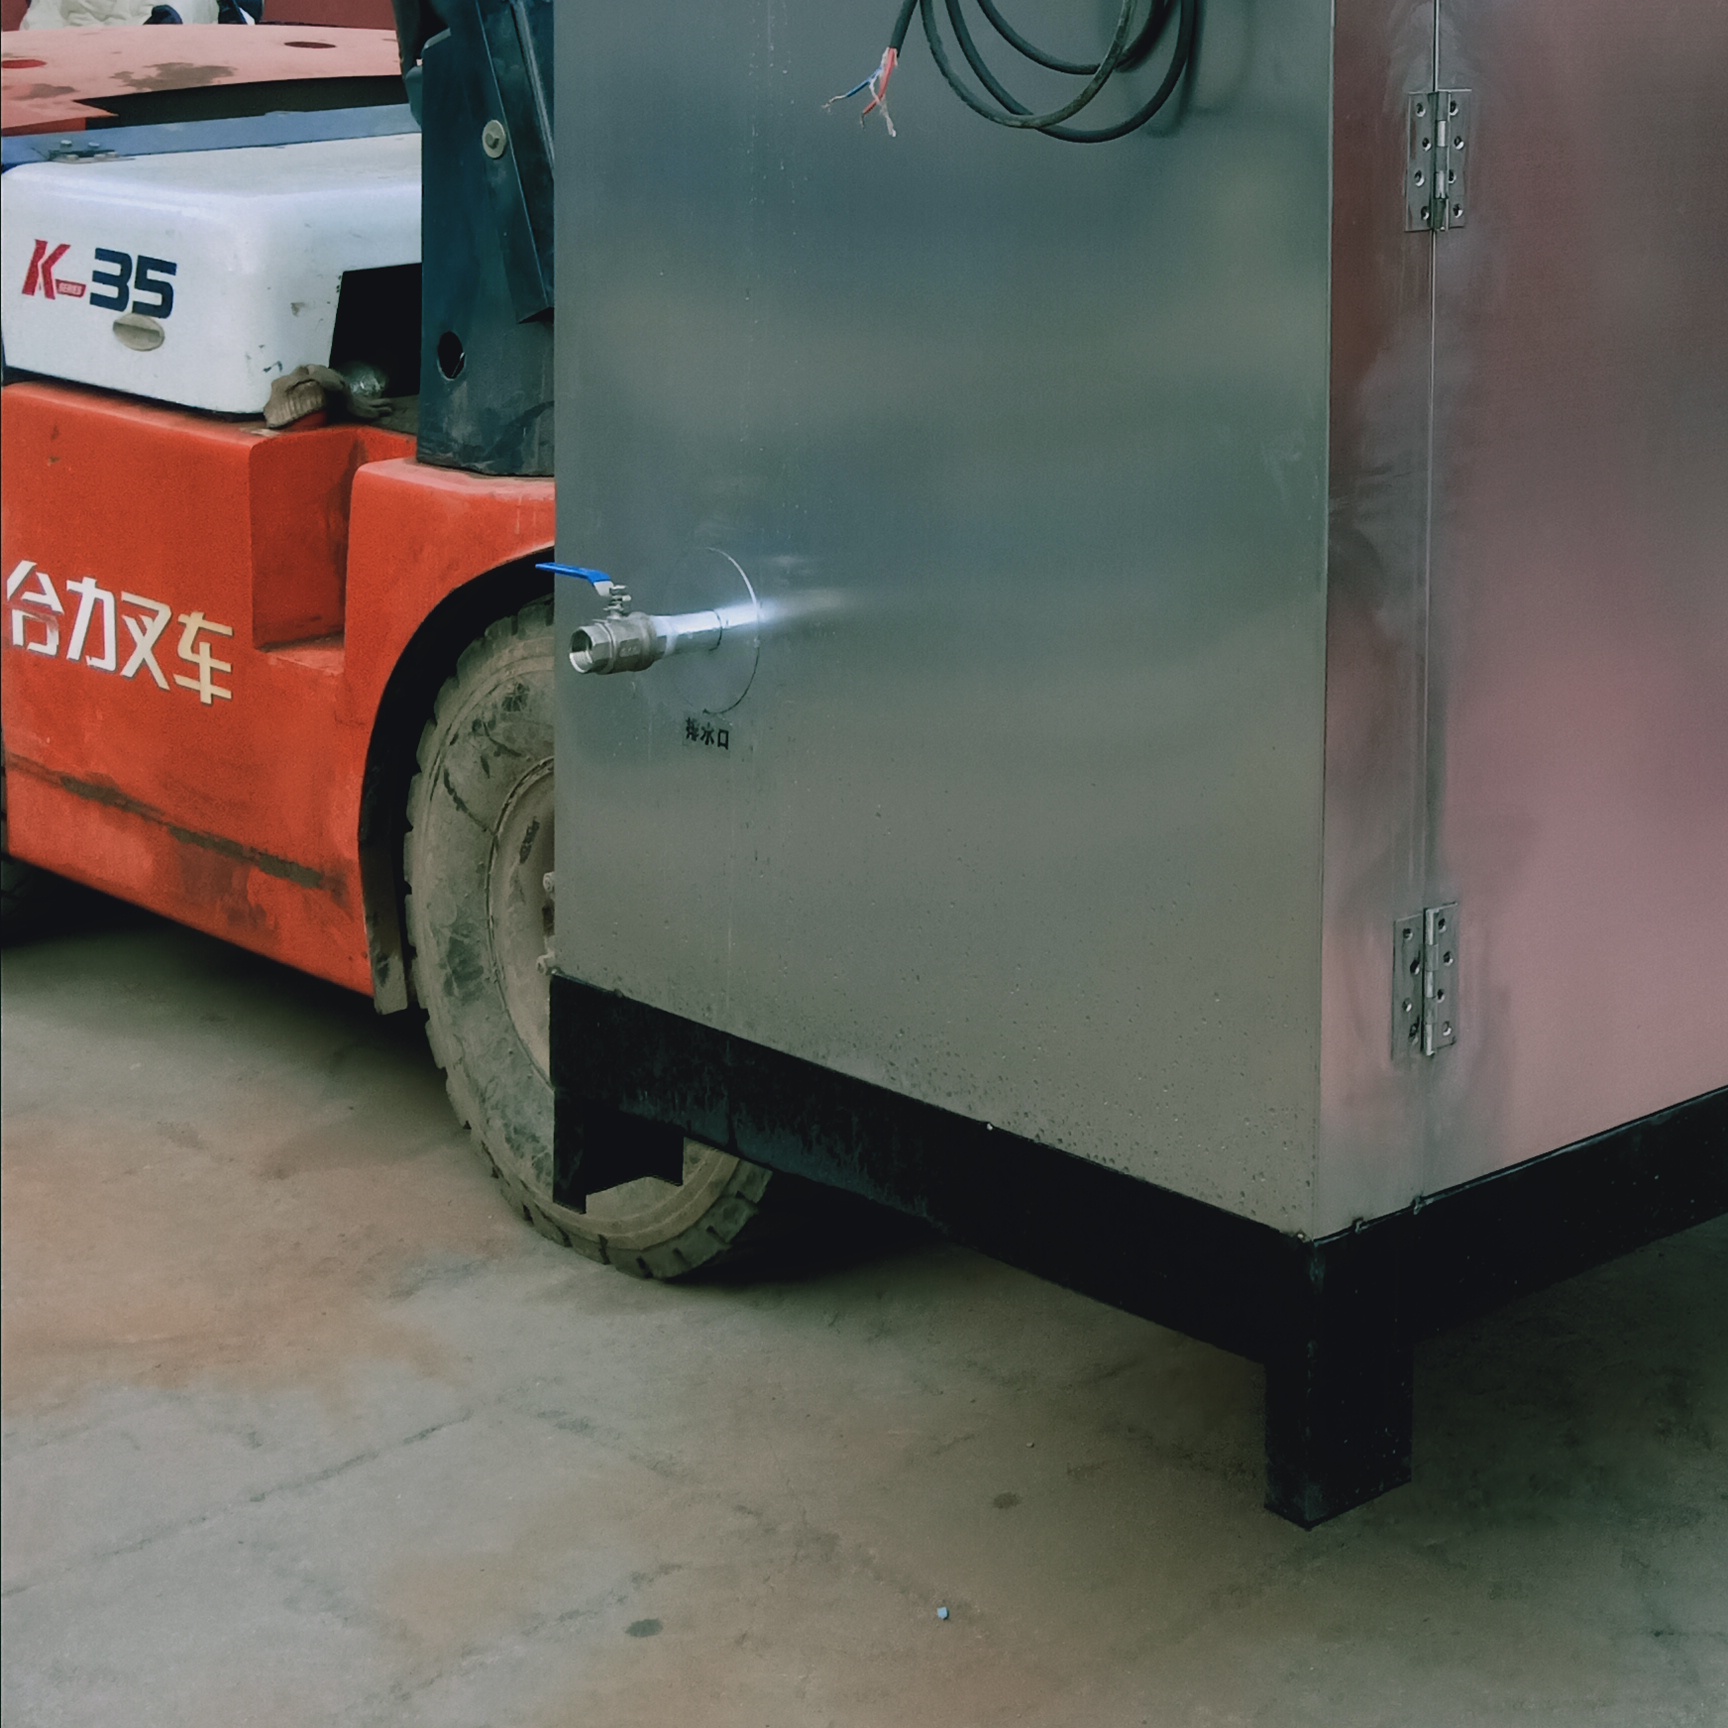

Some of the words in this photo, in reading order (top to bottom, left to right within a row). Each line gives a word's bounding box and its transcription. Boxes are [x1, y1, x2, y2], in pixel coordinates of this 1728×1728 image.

[90, 247, 177, 319] 35
[6, 559, 234, 705] 合力叉车
